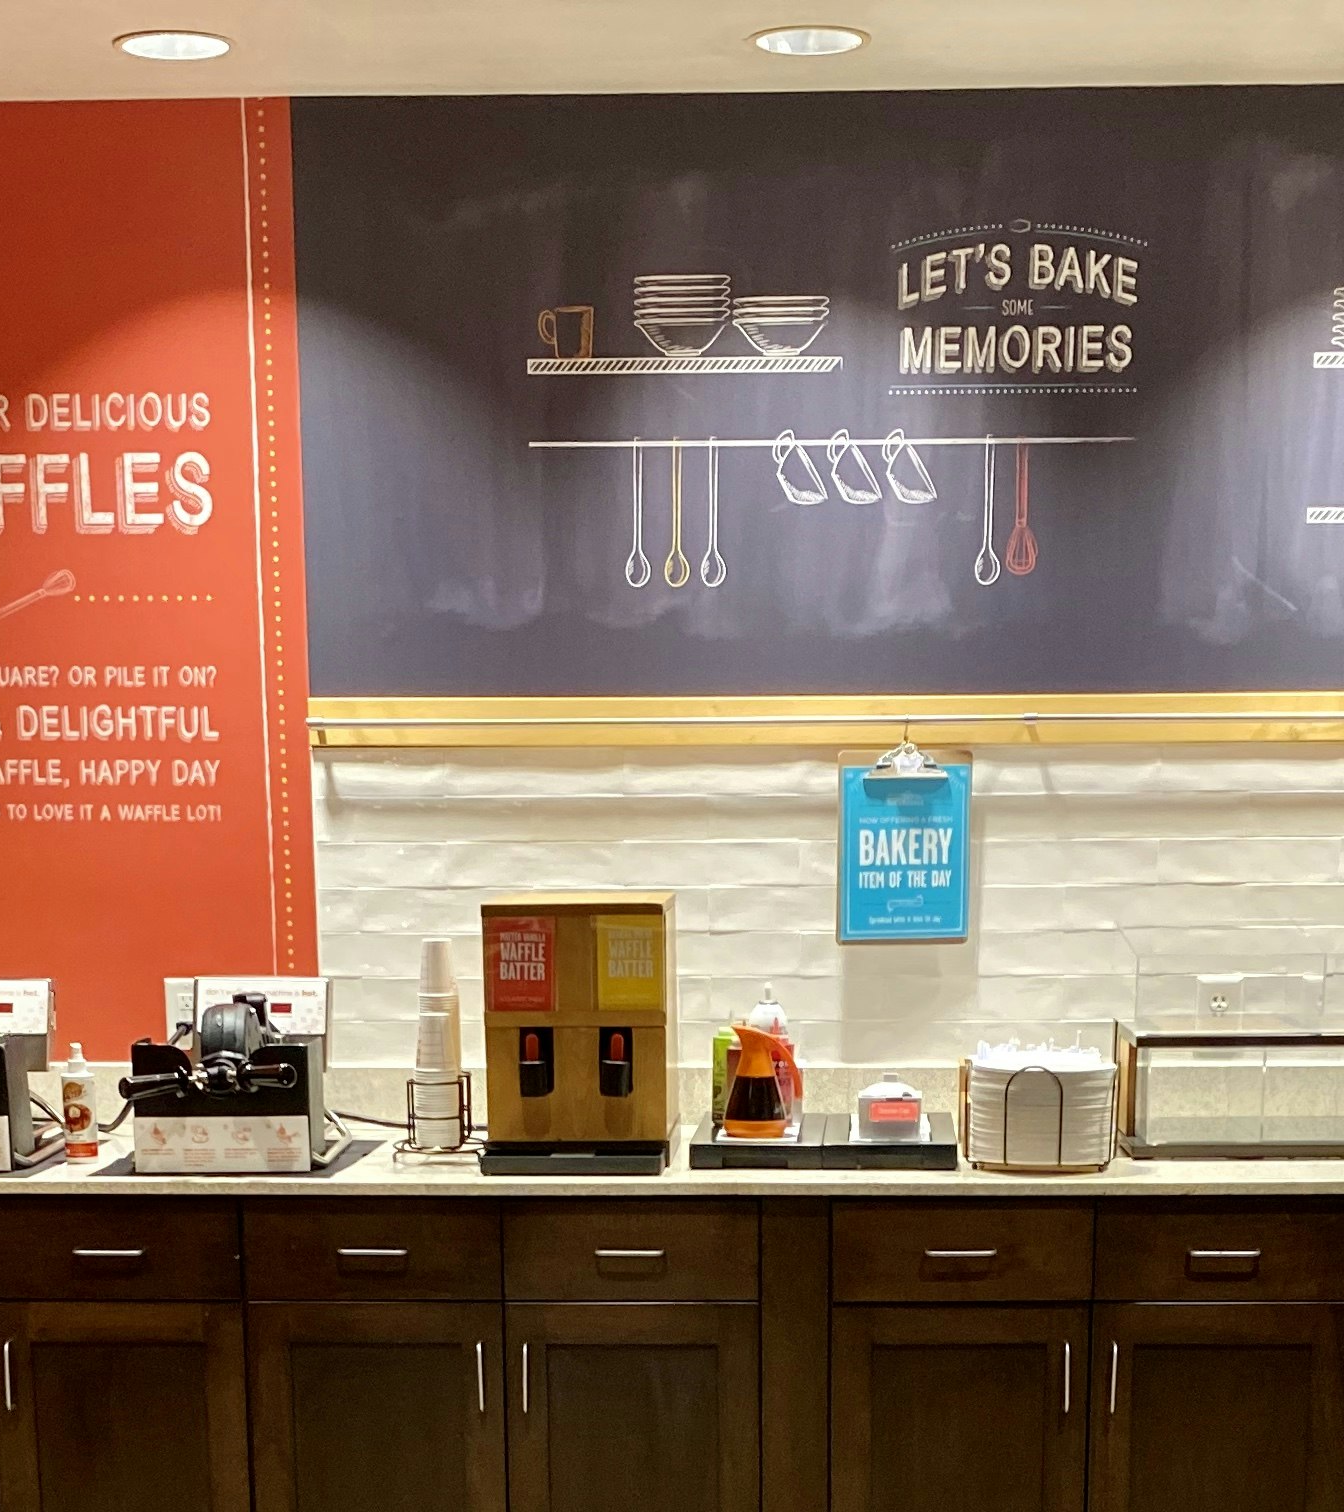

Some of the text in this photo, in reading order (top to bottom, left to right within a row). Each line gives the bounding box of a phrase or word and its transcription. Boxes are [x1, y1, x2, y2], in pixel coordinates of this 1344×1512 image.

[897, 243, 1138, 310] LET'S BAKE
[1001, 299, 1034, 316] SOME
[900, 324, 1133, 374] MEMORIES
[25, 392, 211, 431] DELICIOUS
[68, 666, 97, 687] OR
[104, 666, 145, 687] PILE
[153, 666, 171, 687] IT
[178, 665, 217, 687] ON?
[16, 705, 220, 741] DELIGHTFUL
[79, 759, 161, 786] HAPPY
[172, 759, 221, 786] DAY
[7, 803, 28, 822] TO
[34, 803, 74, 822] LOVE
[79, 803, 94, 822] IT
[100, 803, 112, 822] A
[118, 803, 181, 822] WAFFLE
[187, 803, 222, 822] LOT!
[859, 828, 953, 866] BAKERY
[859, 869, 952, 889] ITEM OF THE DAY
[500, 943, 545, 961] WAFFLE
[608, 940, 653, 959] WAFFLE
[500, 962, 545, 981] BATTER
[608, 960, 653, 978] BATTER
